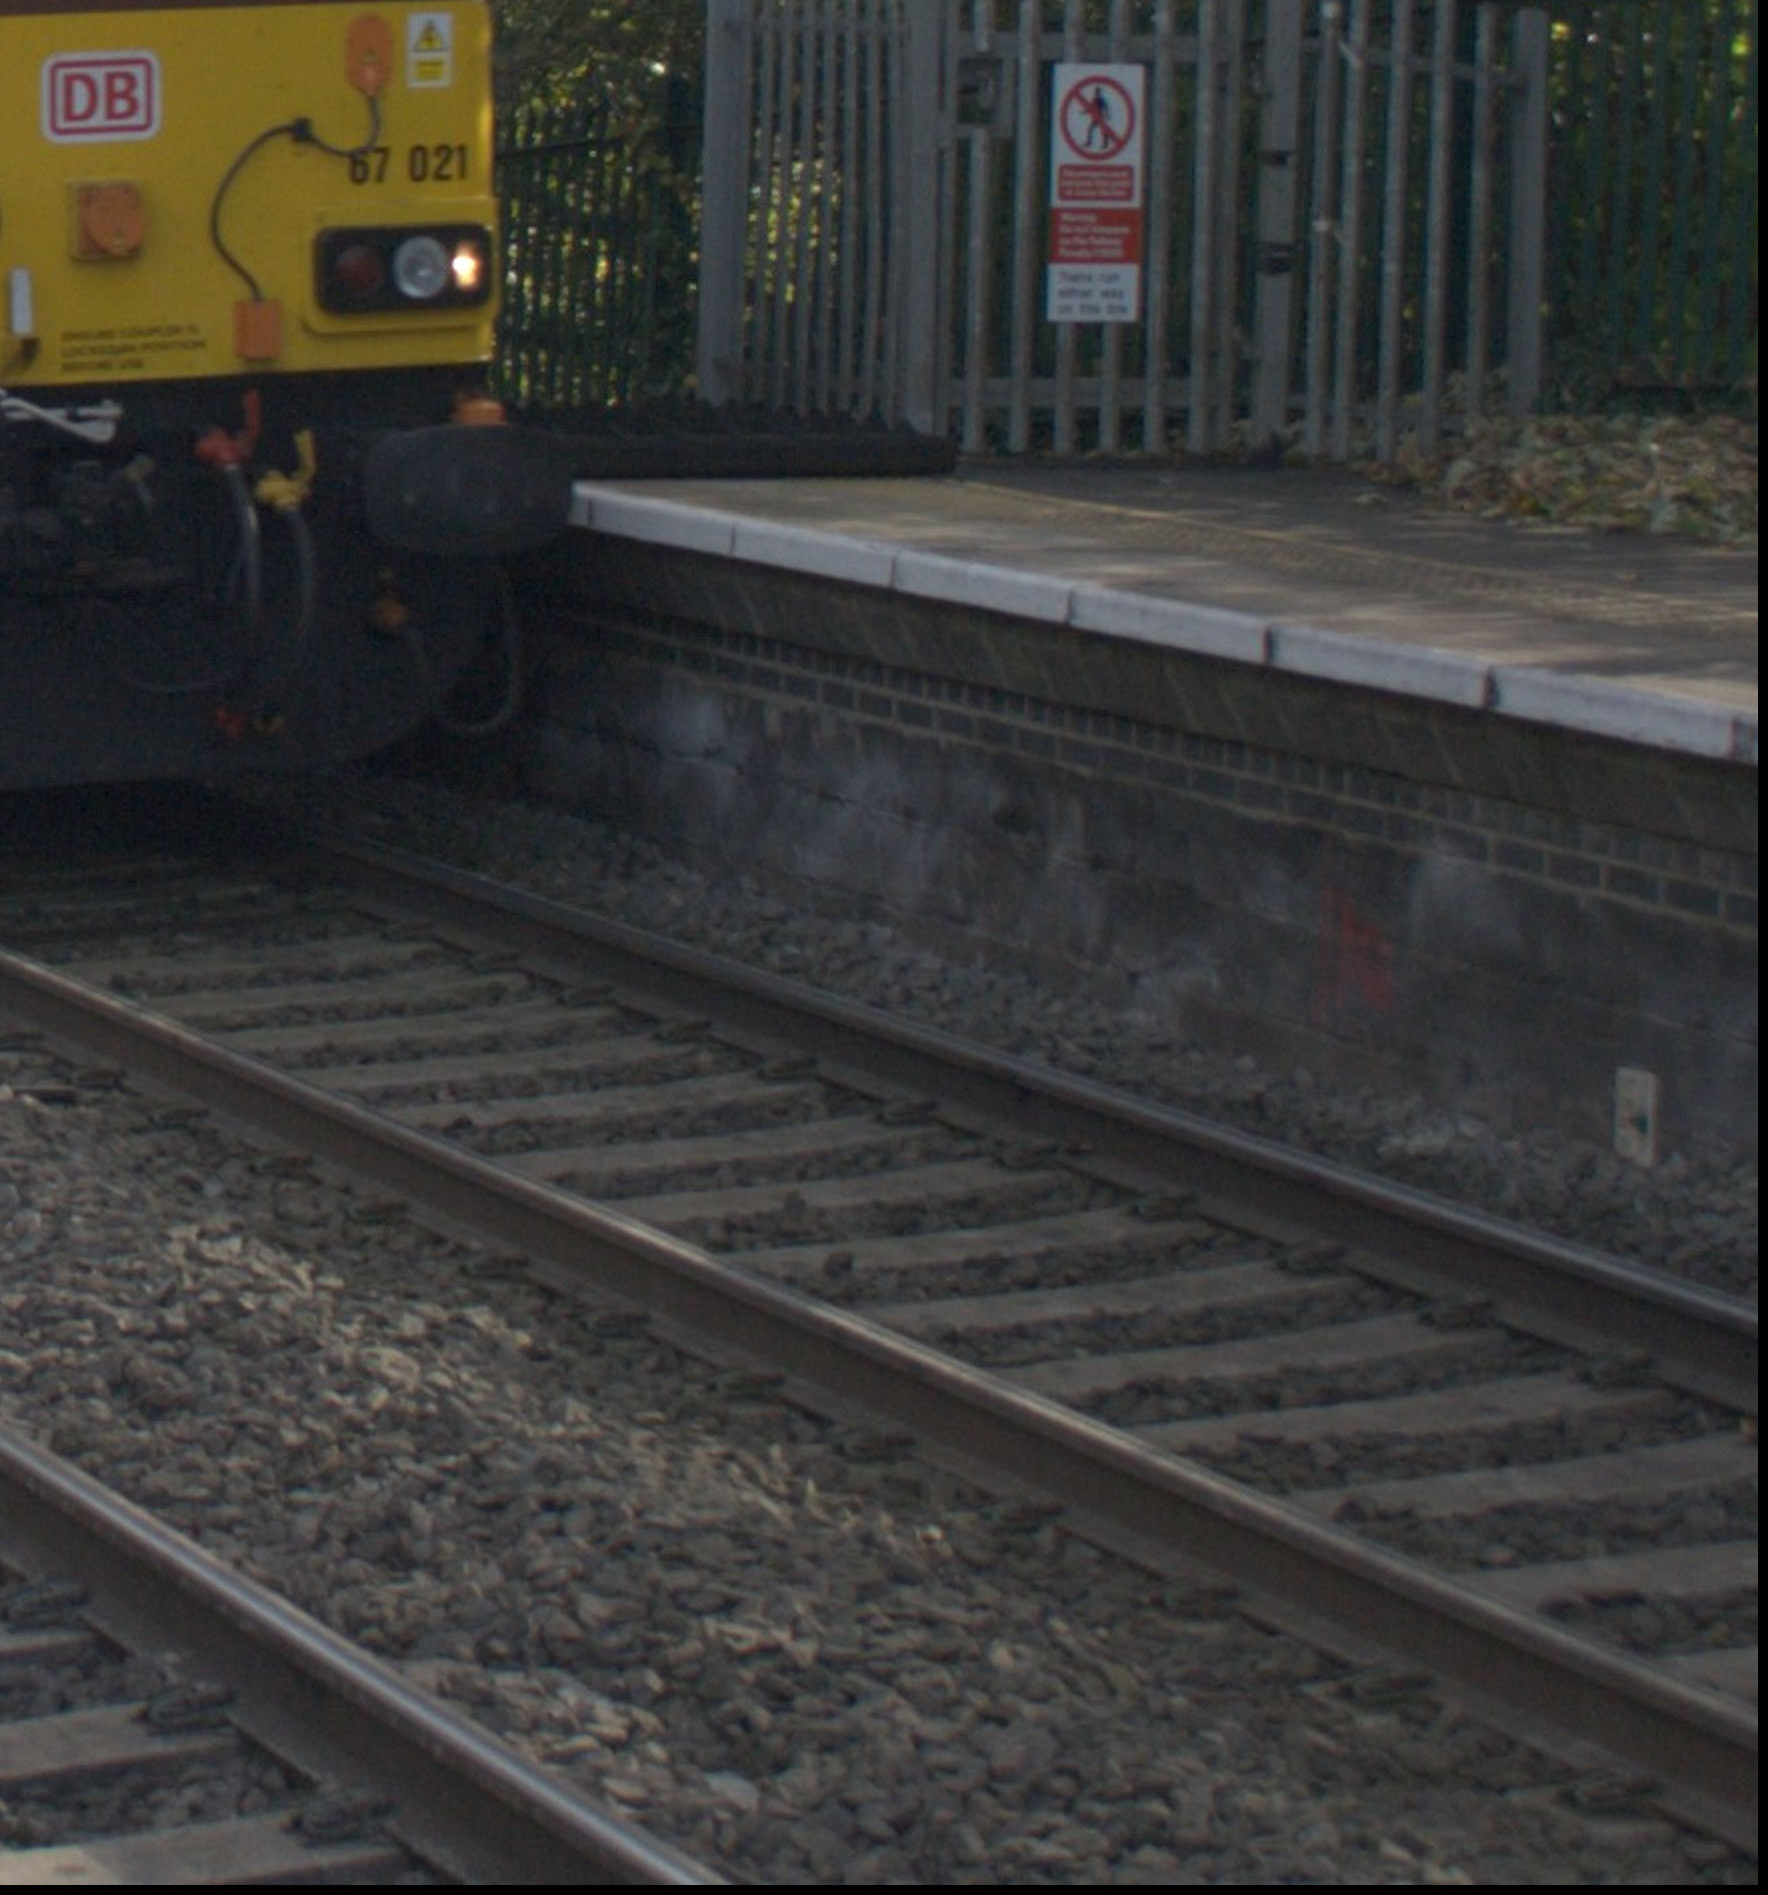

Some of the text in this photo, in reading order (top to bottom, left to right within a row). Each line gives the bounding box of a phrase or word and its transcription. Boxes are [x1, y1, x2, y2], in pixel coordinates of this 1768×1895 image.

[64, 72, 139, 121] DB
[349, 144, 468, 185] 67 021
